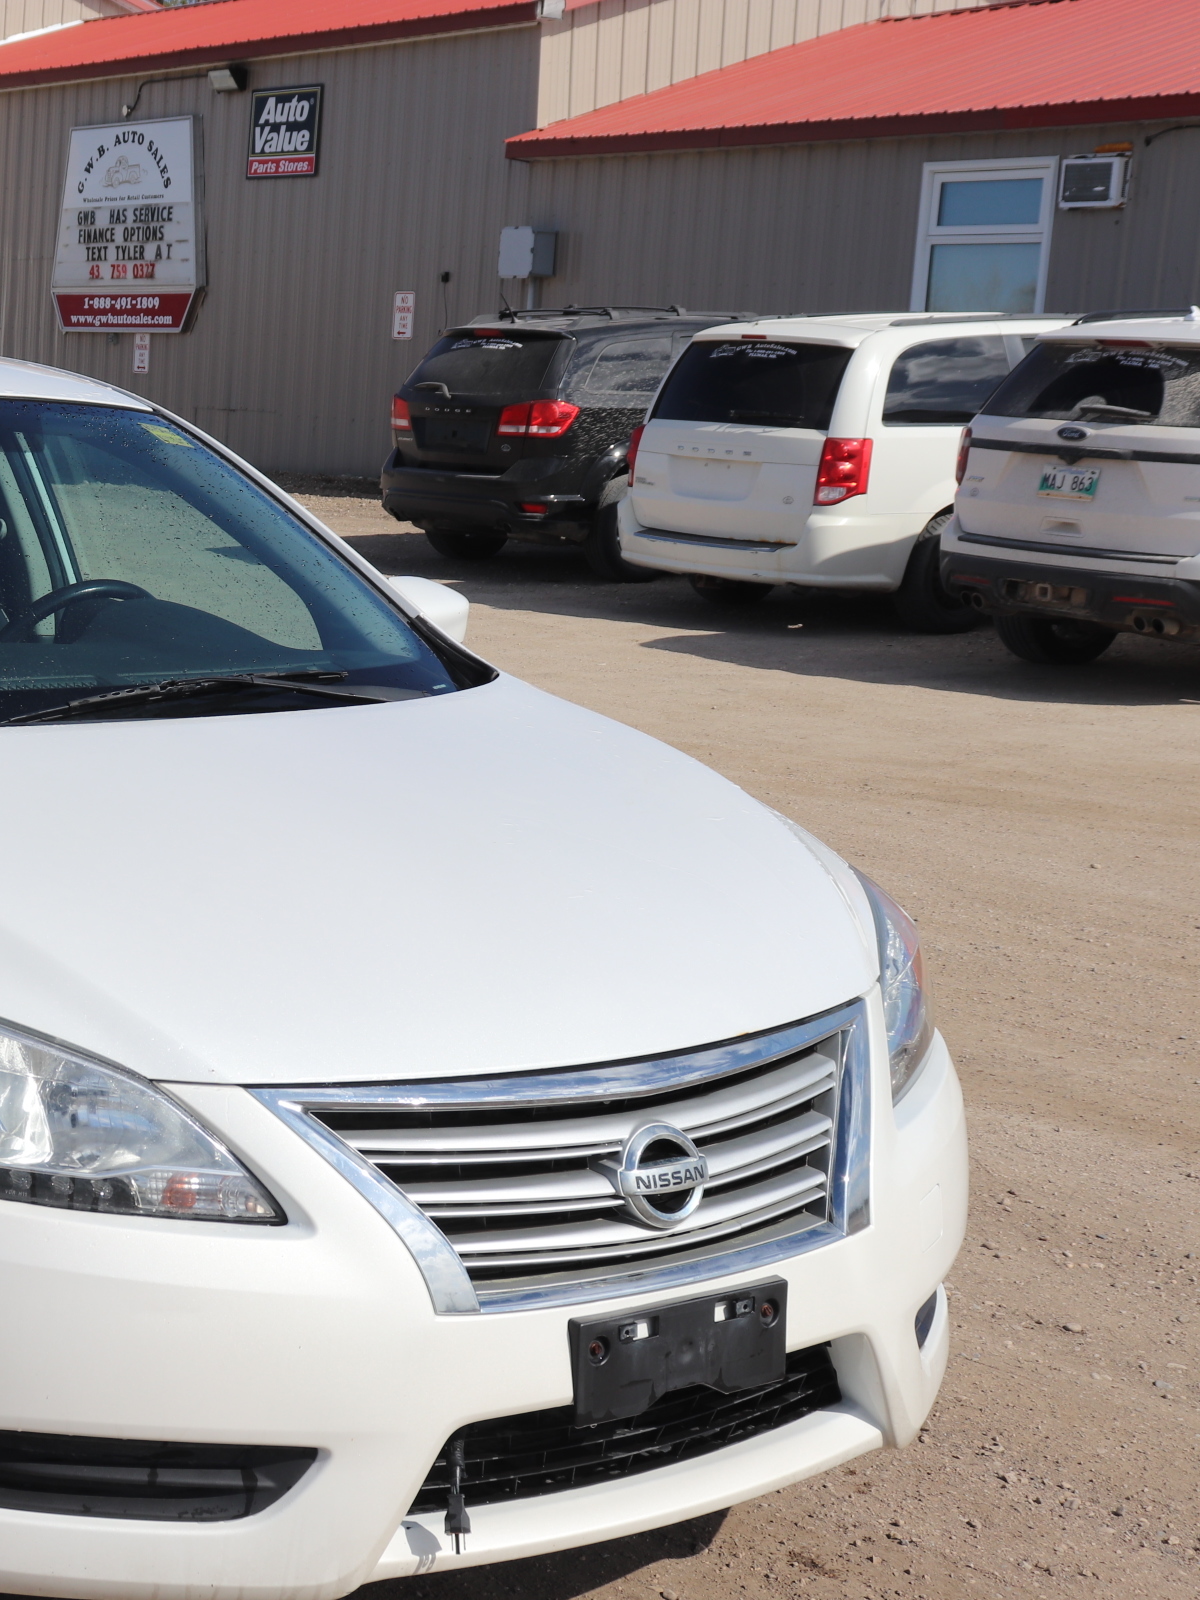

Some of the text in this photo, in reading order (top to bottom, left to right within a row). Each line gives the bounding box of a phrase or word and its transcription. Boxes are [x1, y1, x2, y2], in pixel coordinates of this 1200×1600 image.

[258, 94, 310, 124] Auto
[254, 125, 310, 153] Value
[114, 131, 145, 147] AUTO
[147, 140, 171, 189] SALES
[250, 160, 308, 173] Parts Stores
[77, 206, 173, 226] GWB HAS SERVICE
[78, 225, 164, 244] FINANCE OPTIONS
[85, 246, 108, 261] TEXT
[115, 245, 145, 260] TYLER
[110, 263, 127, 279] 759
[83, 296, 160, 310] 1-888-491-1809
[401, 296, 408, 304] NO
[70, 313, 172, 326] www.gwbautosales.com
[677, 445, 752, 456] DODGE
[1041, 472, 1094, 491] MAJ 863
[635, 1164, 705, 1189] NISSAN
